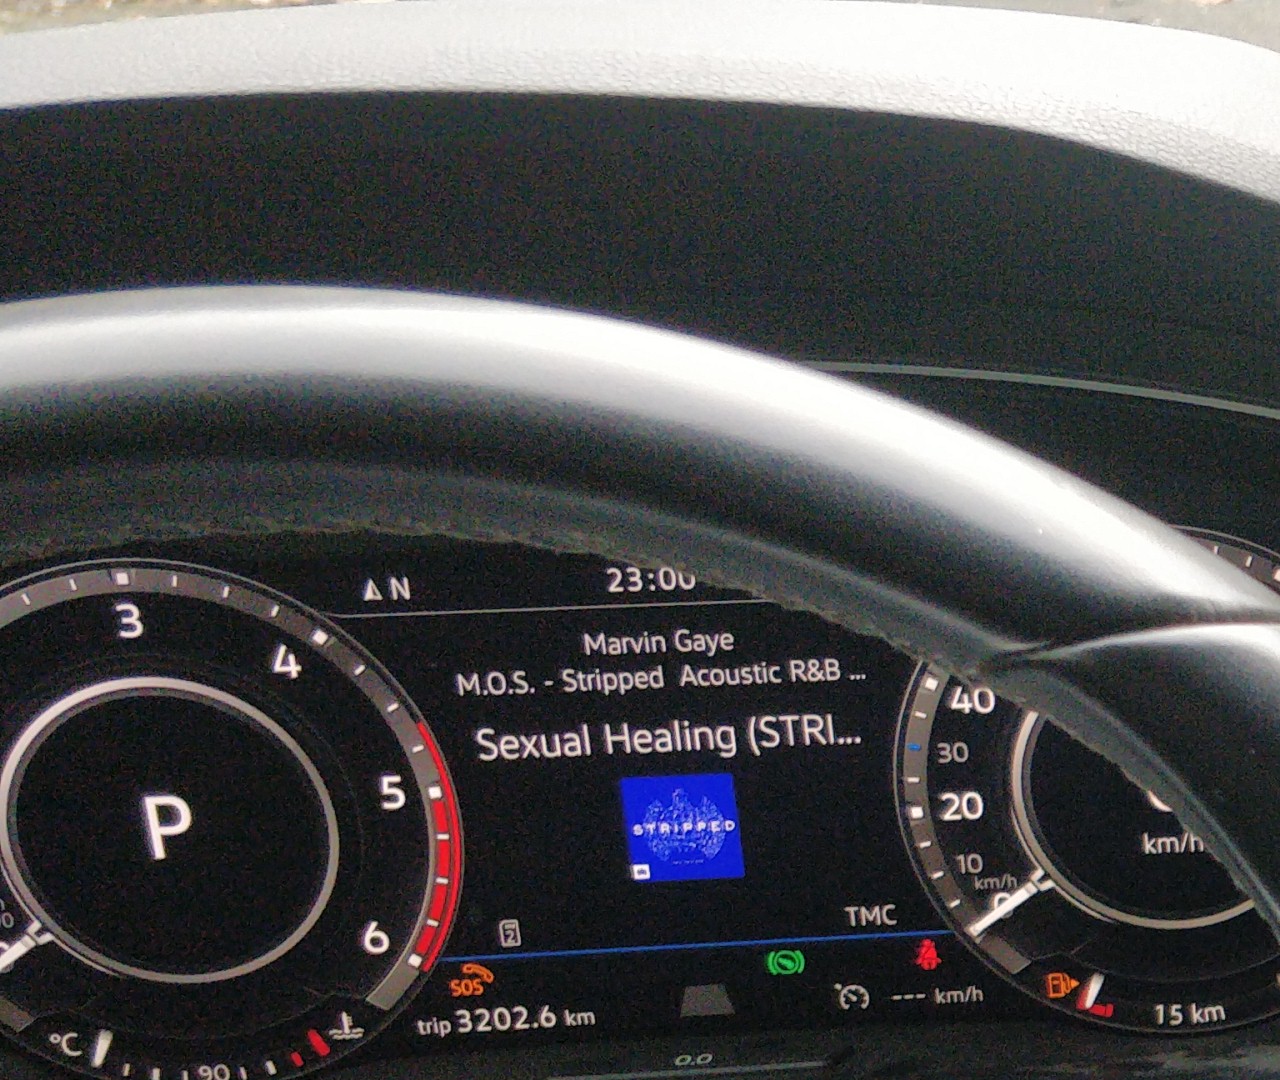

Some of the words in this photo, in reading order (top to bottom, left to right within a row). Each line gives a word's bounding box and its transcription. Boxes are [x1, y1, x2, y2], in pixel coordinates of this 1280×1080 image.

[390, 577, 411, 600] N
[606, 567, 696, 593] 23:00
[114, 604, 143, 637] 3
[583, 632, 666, 656] Marvin
[675, 629, 735, 657] Gaye
[272, 645, 301, 679] 4
[457, 671, 536, 696] M.O.S.
[562, 666, 664, 695] Stripped
[680, 662, 781, 687] Acoustic
[791, 659, 842, 682] R&B
[950, 687, 996, 714] 40
[475, 724, 591, 761] Sexual
[604, 720, 736, 758] Healing
[937, 742, 969, 762] 30
[380, 776, 406, 809] 5
[939, 791, 984, 821] 20
[143, 795, 192, 860] P
[633, 820, 735, 836] STRIPPED
[1142, 830, 1204, 854] km/h
[956, 853, 984, 875] 10
[974, 874, 1018, 890] km/h
[844, 905, 897, 926] TMC
[363, 922, 389, 954] 6
[451, 980, 484, 996] SOS
[934, 986, 984, 1005] km/h
[417, 1019, 451, 1036] trip
[457, 1007, 556, 1033] 3202.6
[564, 1008, 595, 1026] km
[1154, 1004, 1184, 1026] 15
[1191, 1003, 1226, 1023] km
